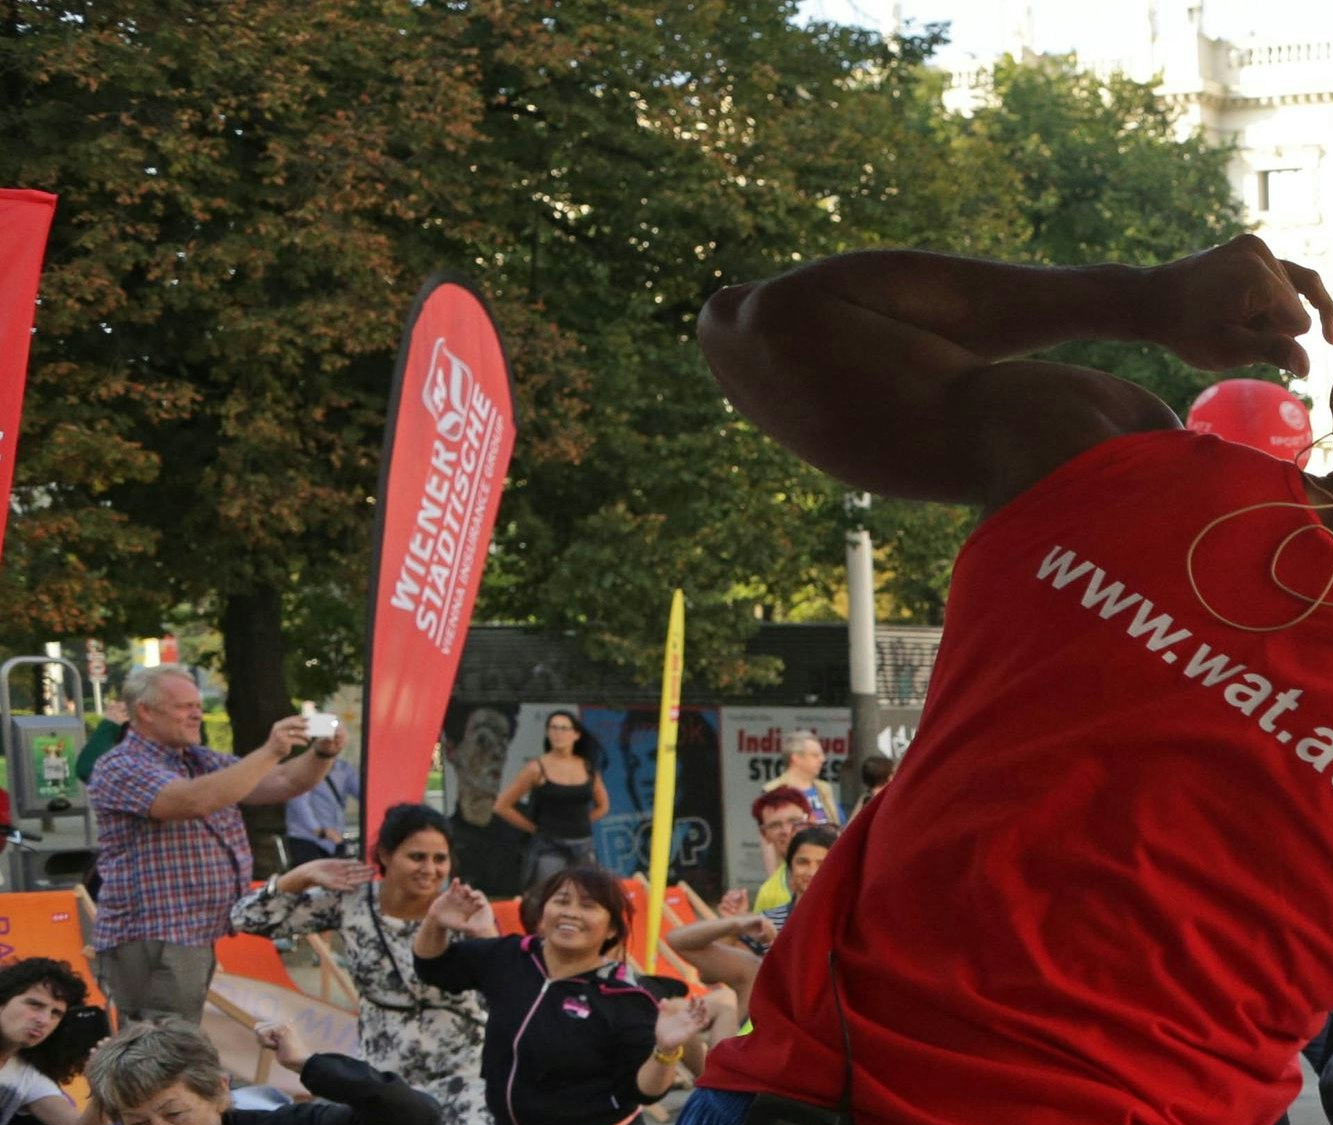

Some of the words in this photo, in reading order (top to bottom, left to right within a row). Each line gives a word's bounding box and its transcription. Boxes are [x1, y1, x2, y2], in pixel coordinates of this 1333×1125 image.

[390, 440, 459, 613] WIENER
[415, 384, 492, 639] STÄDTISCHE
[442, 588, 466, 656] VIENNA
[459, 482, 492, 585] INSURANCE
[737, 727, 854, 754] Indiual
[602, 816, 713, 874] POP
